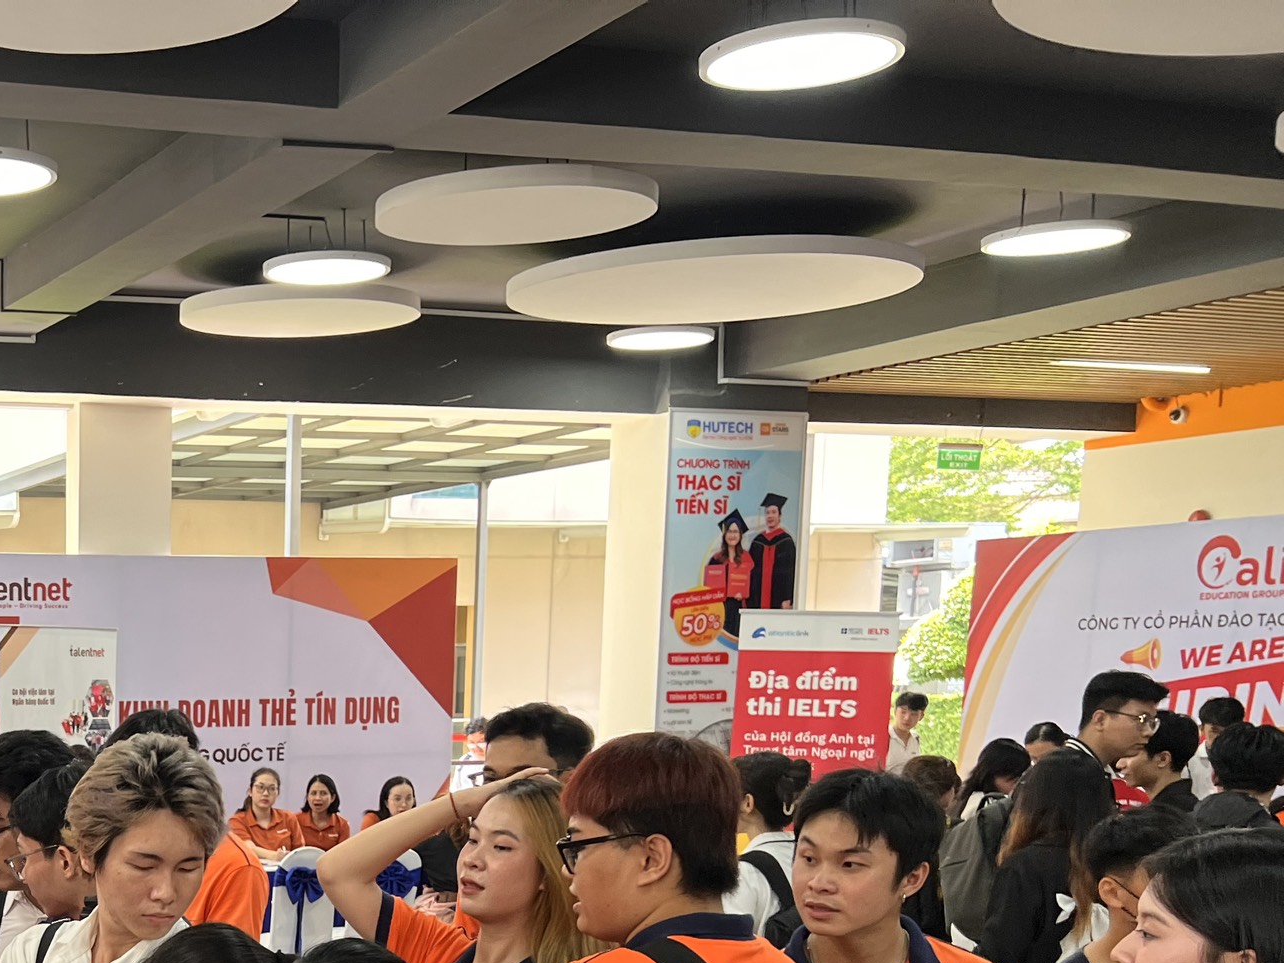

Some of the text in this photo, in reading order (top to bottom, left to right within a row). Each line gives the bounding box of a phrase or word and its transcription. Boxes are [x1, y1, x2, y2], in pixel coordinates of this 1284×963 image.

[702, 421, 754, 434] HUTECH
[1199, 591, 1250, 600] EDUCATION
[681, 613, 721, 636] 50%
[1078, 614, 1119, 631] CÔNG
[1122, 616, 1141, 630] TY
[1143, 609, 1165, 630] CỔ
[1169, 609, 1213, 629] PHẦN
[1217, 609, 1253, 628] ĐÀO
[867, 628, 890, 636] IELTS
[69, 645, 105, 658] talentnet
[1179, 636, 1284, 670] WE ARE
[748, 667, 858, 695] Địa điểm
[259, 688, 297, 727] THẺ
[305, 691, 336, 726] TÍN
[345, 696, 400, 731] DỤNG
[746, 697, 858, 718] thi IELTS
[743, 730, 767, 742] của
[770, 731, 791, 744] Hội
[795, 731, 826, 746] đồng
[829, 733, 854, 744] Anh
[857, 734, 875, 748] tại
[212, 742, 264, 765] QUỐC
[266, 741, 288, 761] TẾ
[782, 745, 807, 756] tâm
[811, 747, 847, 760] Ngoại
[850, 748, 875, 761] ngữ
